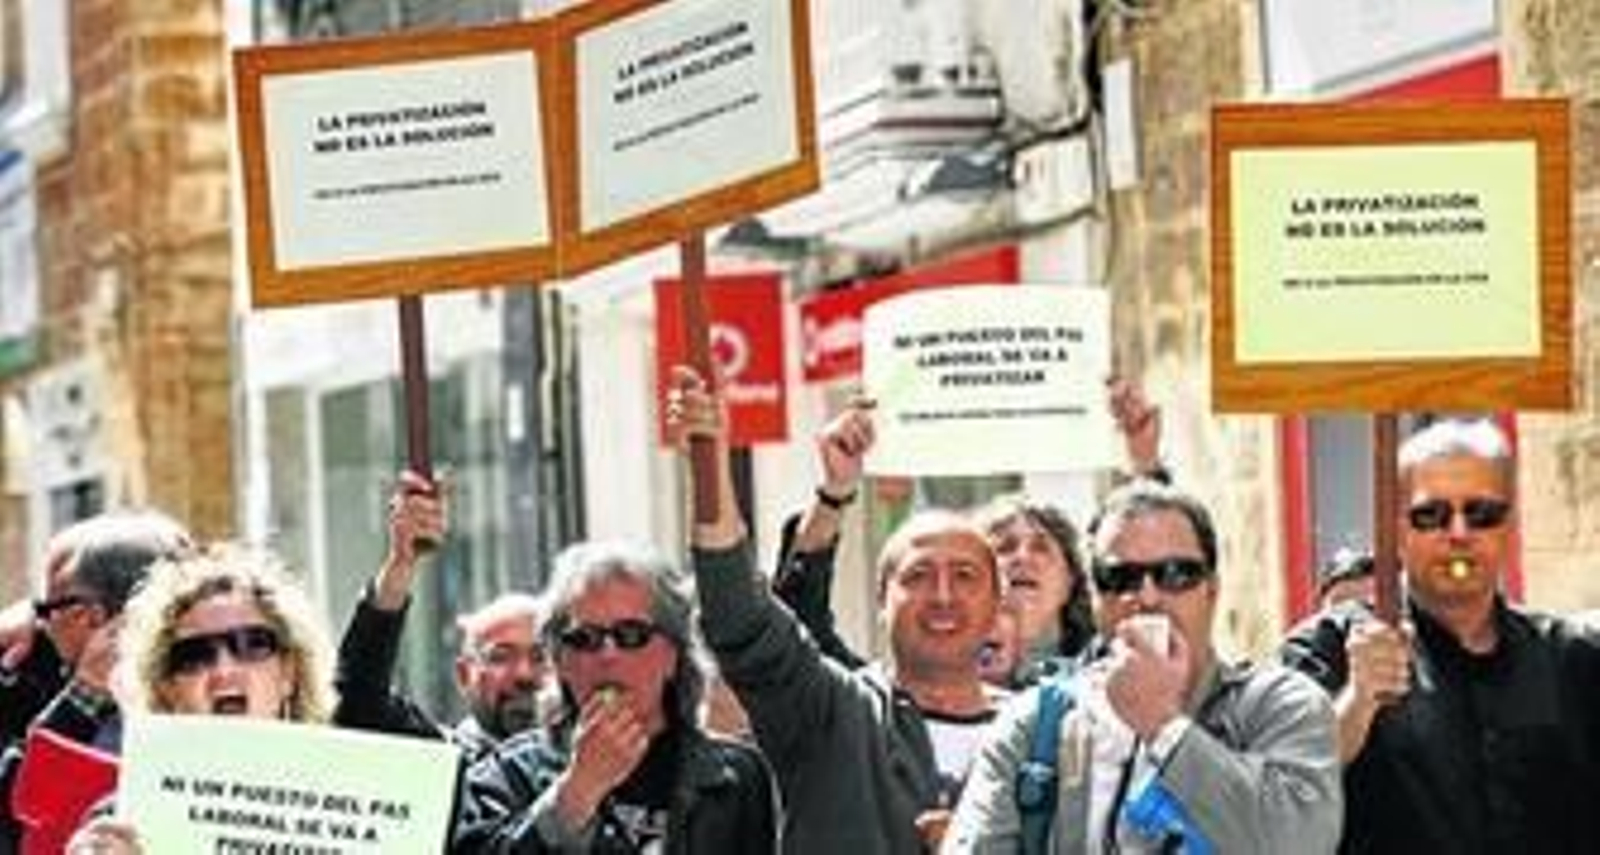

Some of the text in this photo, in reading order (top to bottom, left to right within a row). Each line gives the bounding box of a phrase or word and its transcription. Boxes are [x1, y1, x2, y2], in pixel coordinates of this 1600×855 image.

[317, 116, 342, 132] LA
[313, 138, 342, 153] NO
[346, 136, 369, 151] ES
[374, 132, 396, 148] LA
[1291, 193, 1479, 214] LA PRIVATIZACIÓN
[1286, 217, 1486, 238] NO ES LA SOLUCIÓN
[161, 777, 411, 820] NI UN PUESTO DEL PAS
[188, 807, 378, 841] LABORAL SE VA A
